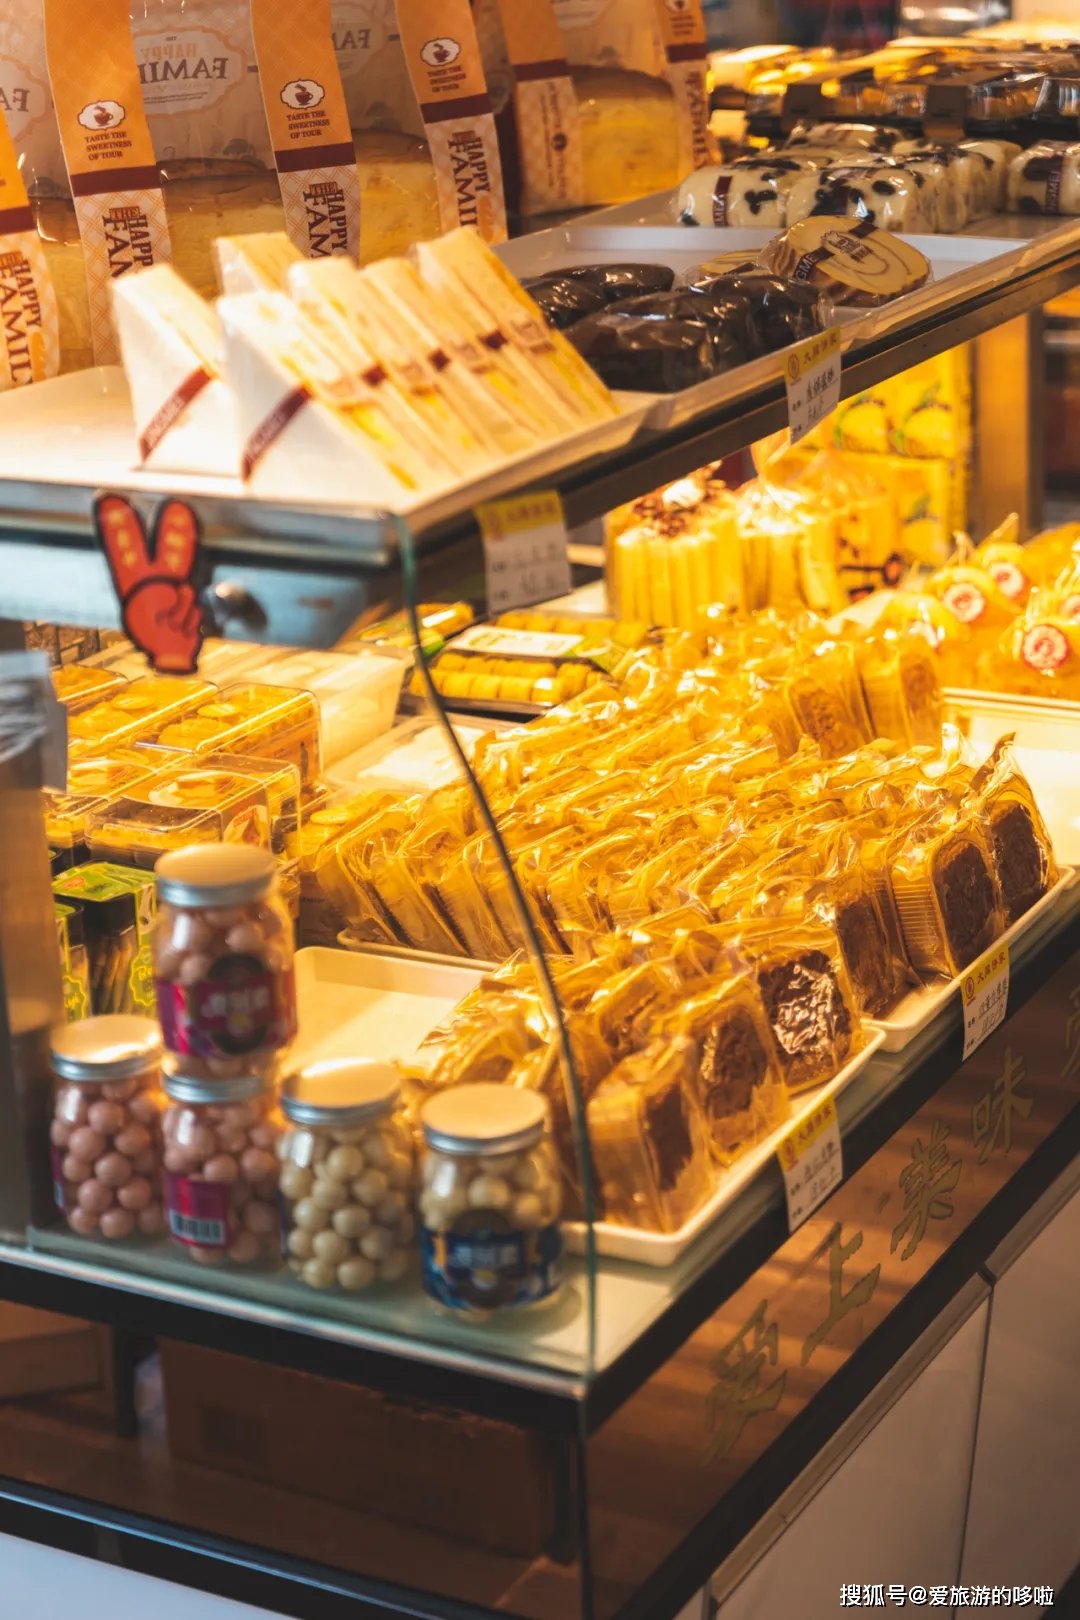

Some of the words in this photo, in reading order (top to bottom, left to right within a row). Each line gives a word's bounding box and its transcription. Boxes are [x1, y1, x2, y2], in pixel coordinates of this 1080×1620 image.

[462, 136, 491, 192] HAPPY
[109, 206, 139, 219] THE
[327, 189, 347, 250] HAPPY
[14, 259, 42, 327] HAPPY
[0, 265, 33, 384] FAMIL
